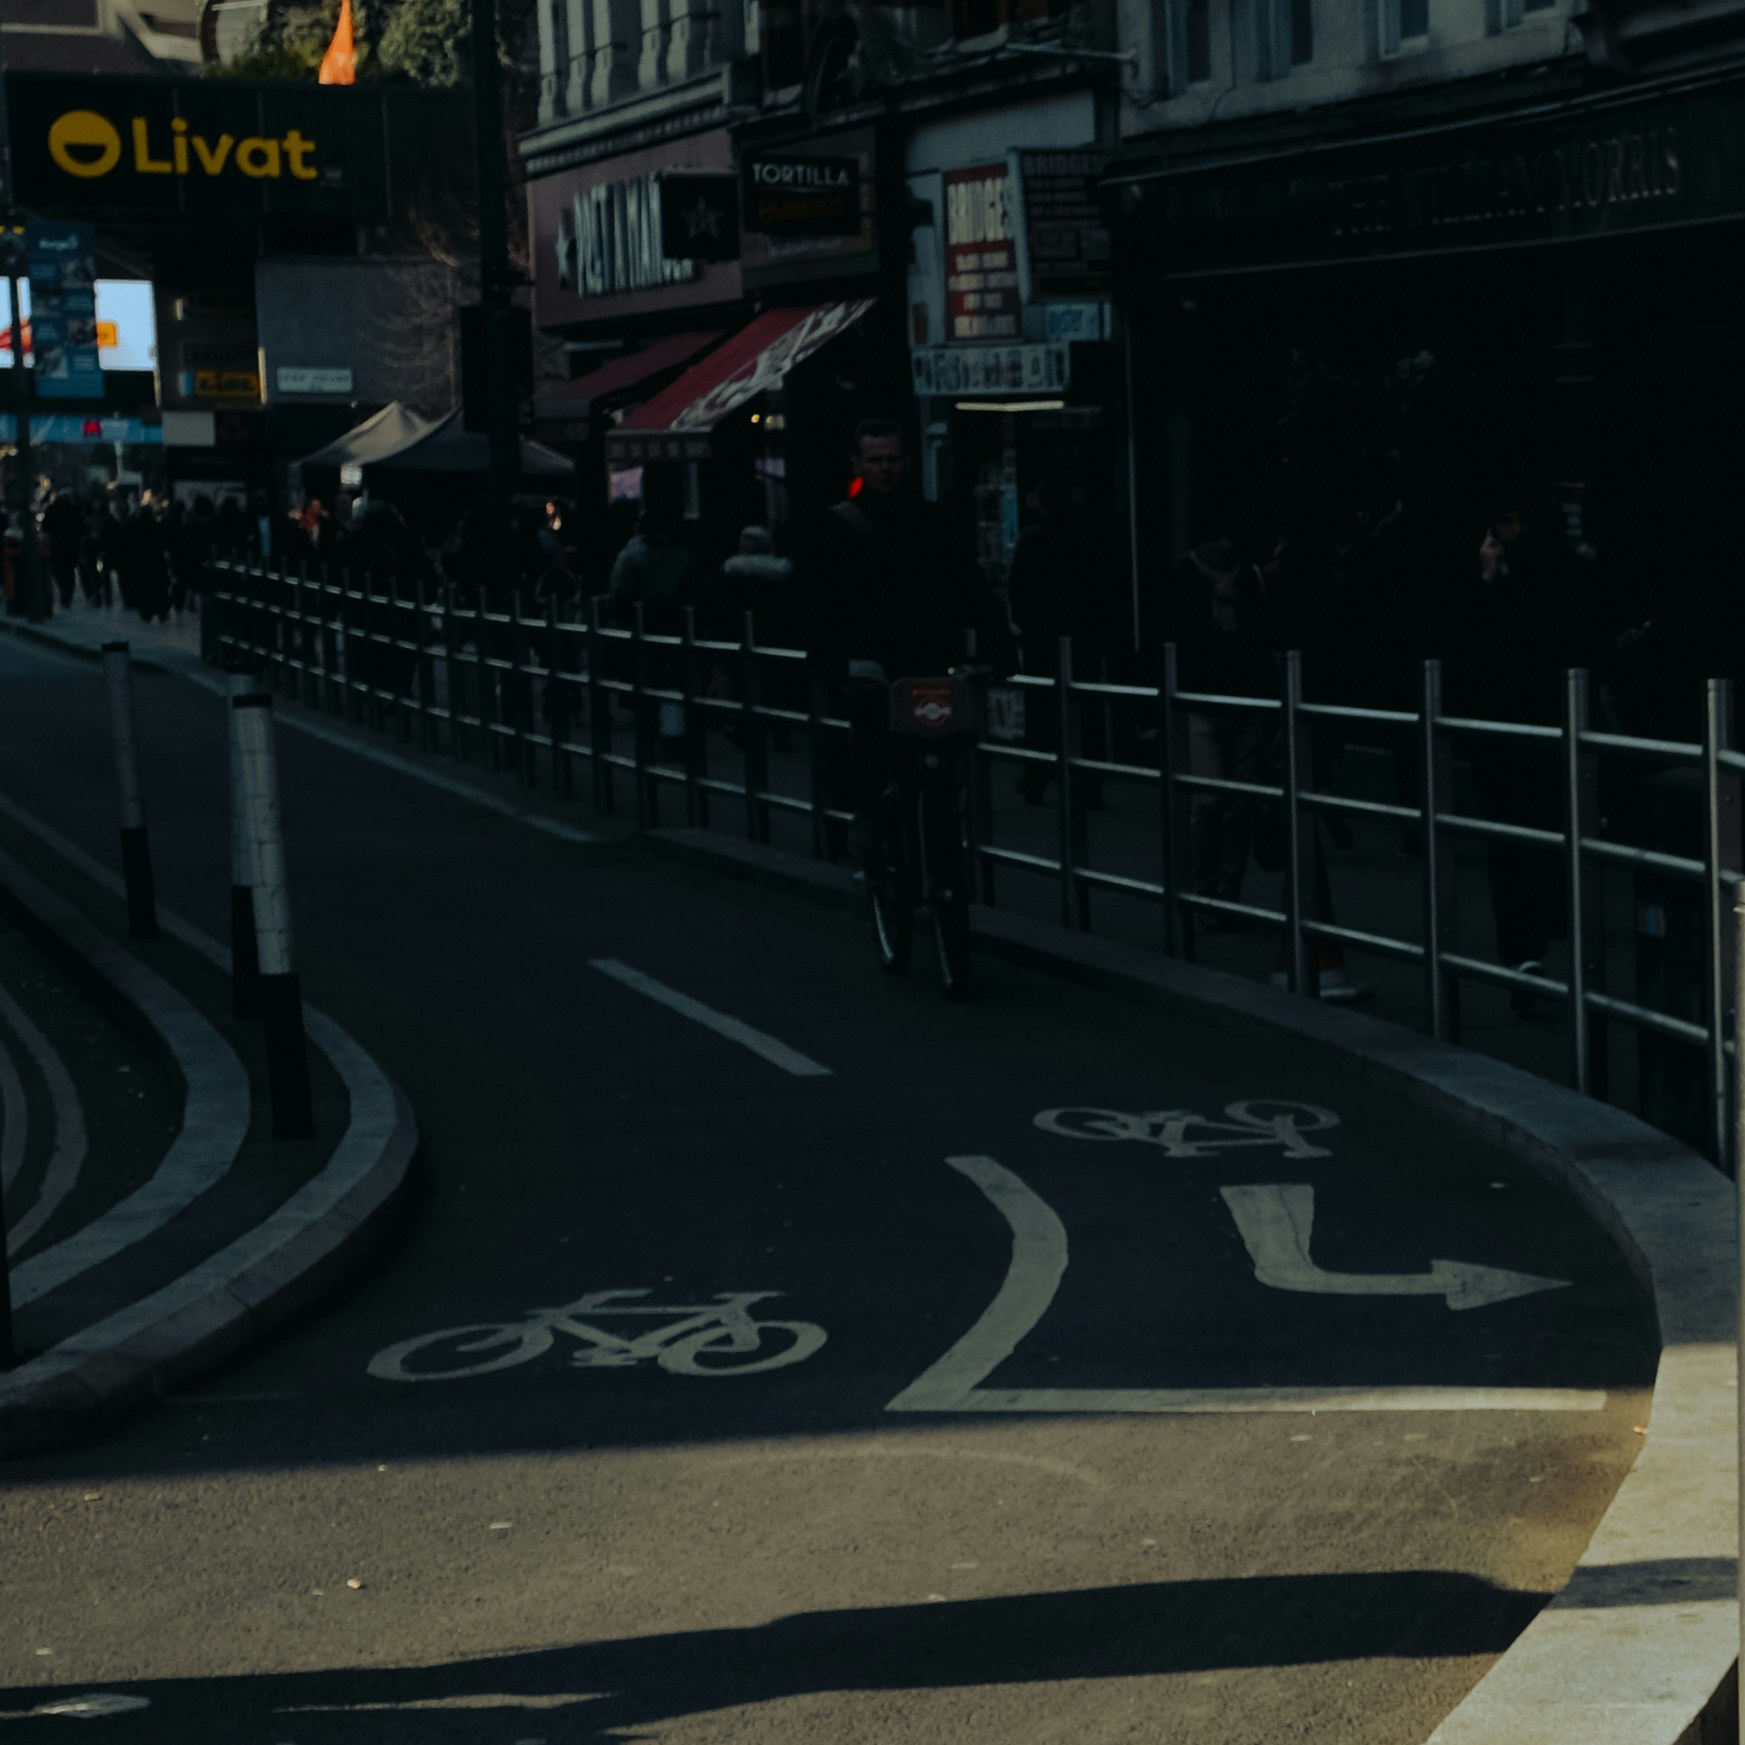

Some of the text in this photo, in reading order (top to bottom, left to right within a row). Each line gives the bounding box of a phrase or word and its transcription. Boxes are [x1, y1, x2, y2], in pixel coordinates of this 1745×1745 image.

[131, 115, 318, 180] Livat
[751, 162, 850, 187] TORTILLA
[1554, 126, 1681, 207] MORRIS
